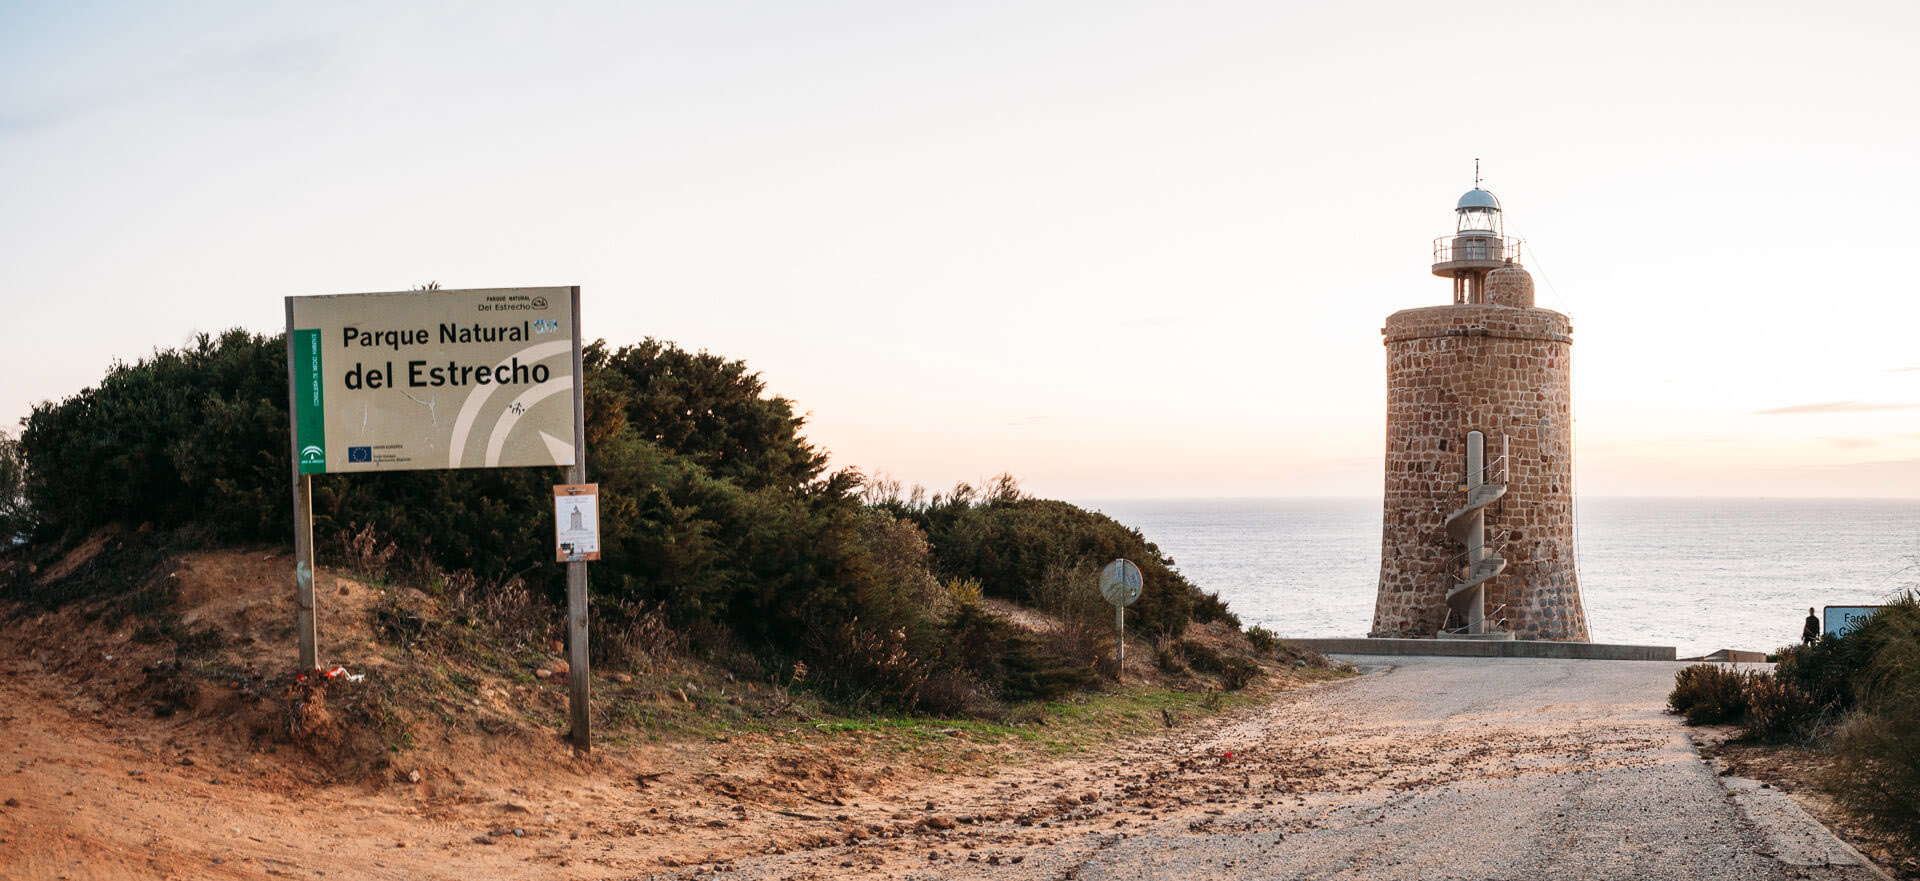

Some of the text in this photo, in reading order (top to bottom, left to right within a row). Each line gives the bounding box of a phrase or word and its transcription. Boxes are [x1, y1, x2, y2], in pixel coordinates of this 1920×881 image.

[478, 302, 531, 312] Del Estrecho
[343, 326, 429, 350] Parque
[439, 320, 530, 344] Natural
[344, 357, 550, 390] del Estrecho
[1844, 613, 1867, 623] Faro
